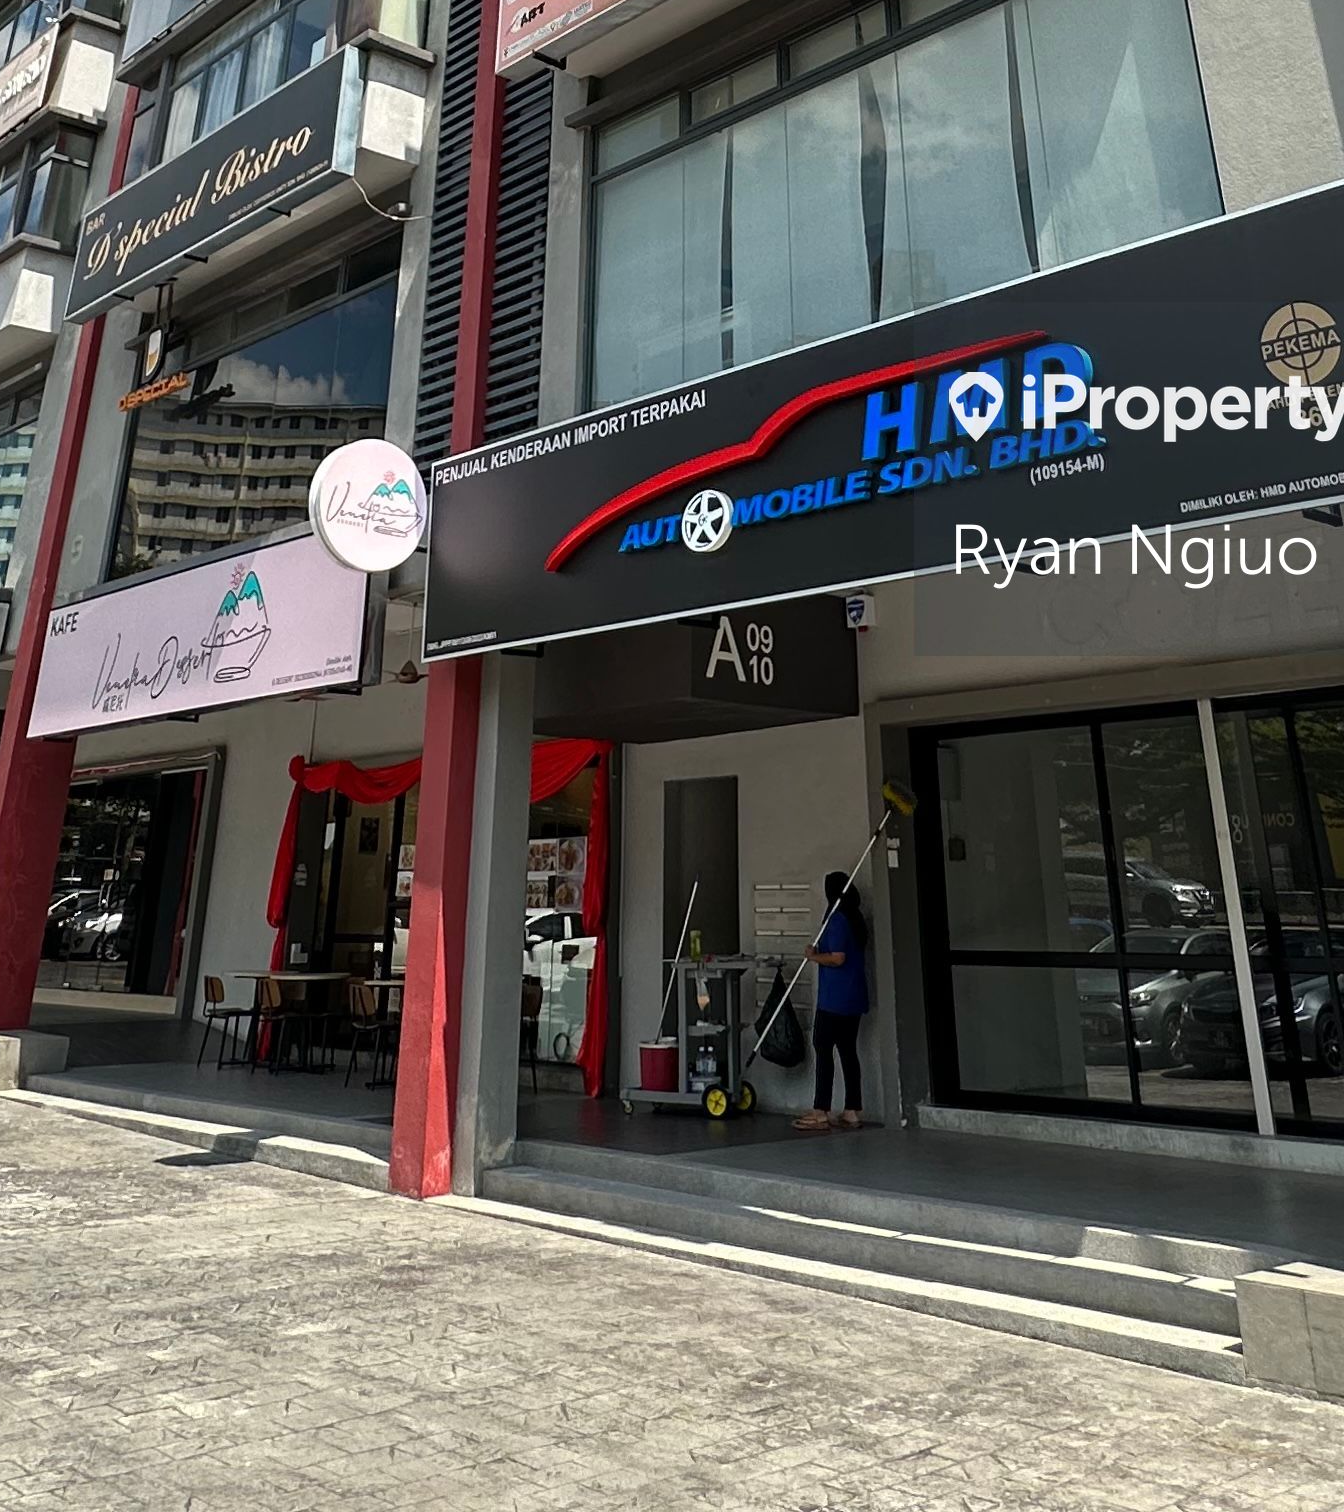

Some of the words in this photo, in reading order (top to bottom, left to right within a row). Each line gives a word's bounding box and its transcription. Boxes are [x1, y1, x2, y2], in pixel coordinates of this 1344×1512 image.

[210, 126, 314, 205] Bistro
[86, 213, 105, 235] BAR
[1261, 329, 1341, 361] PEKEMA
[435, 458, 488, 486] PENJUAL
[490, 430, 571, 471] KENDERAAN
[574, 413, 627, 445] IMPORT
[631, 389, 706, 428] TERPAKAI
[877, 446, 980, 495] SDN.
[1030, 453, 1106, 487] (109154-M)
[1180, 496, 1223, 514] DIMILIKI
[1260, 485, 1287, 499] HMD
[50, 611, 79, 637] KAFE
[746, 622, 774, 654] 09
[706, 615, 747, 682] A
[748, 654, 774, 686] 10
